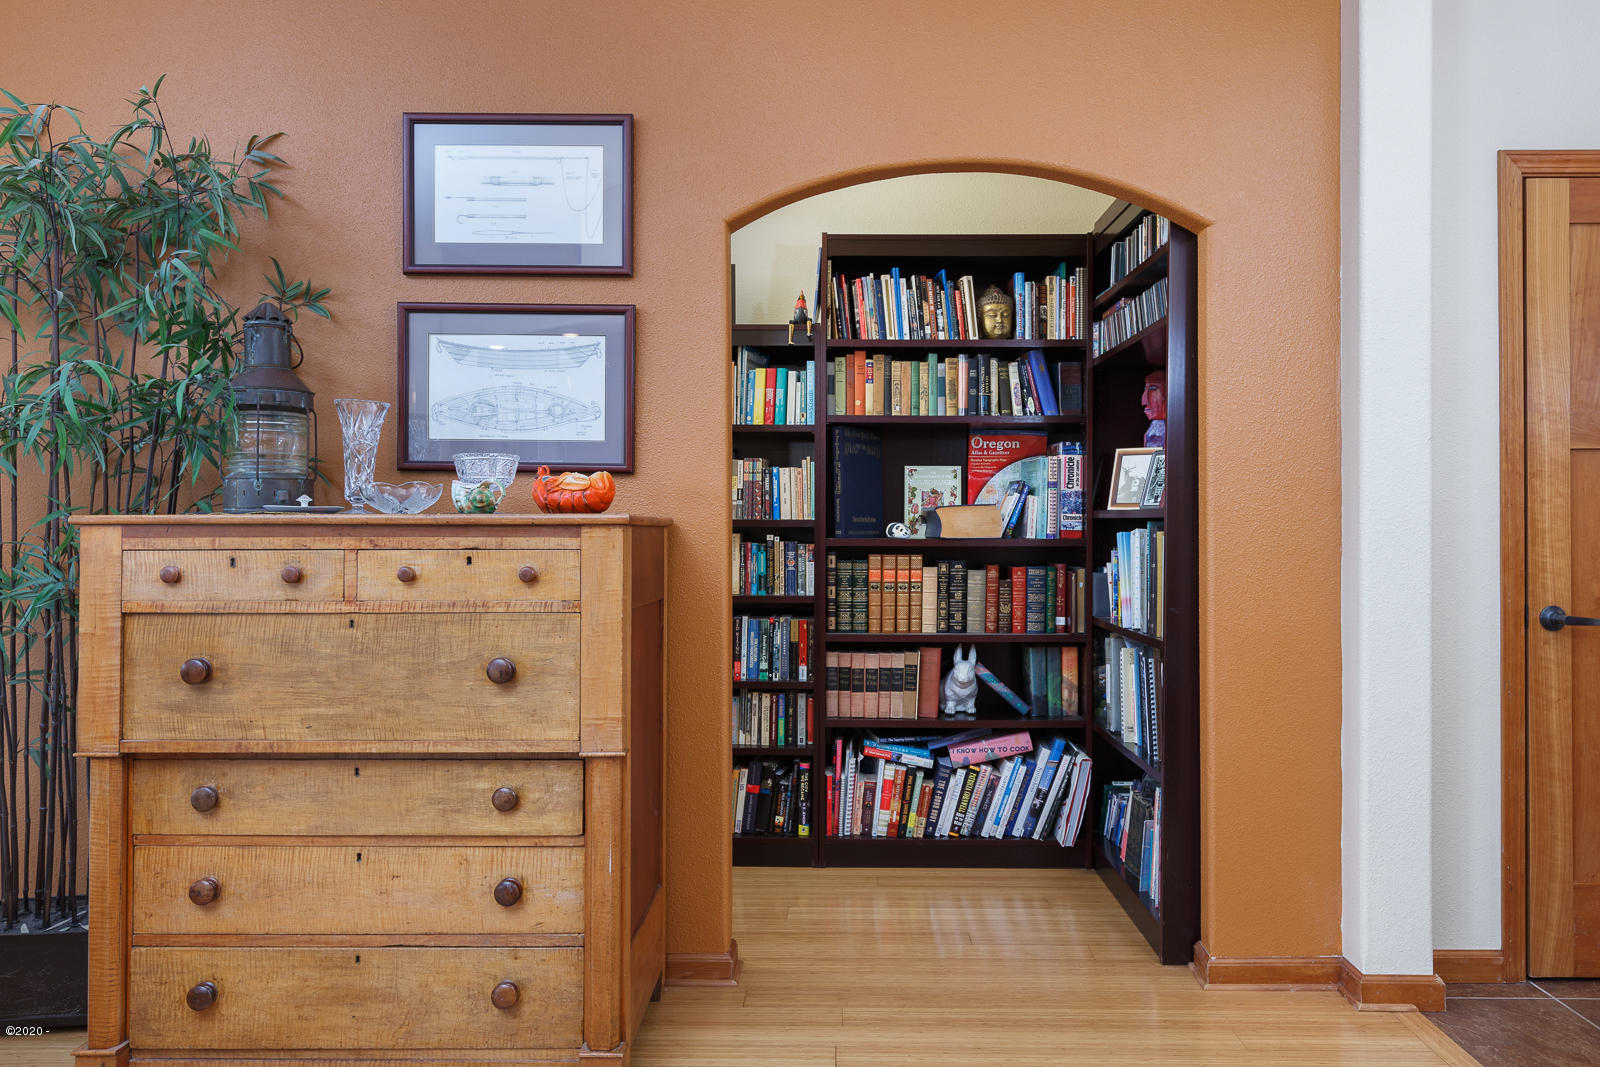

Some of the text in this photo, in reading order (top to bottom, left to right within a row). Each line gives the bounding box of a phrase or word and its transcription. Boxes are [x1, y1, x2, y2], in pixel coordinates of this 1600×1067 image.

[971, 436, 1020, 450] Oregon
[1066, 456, 1074, 489] Chronicle
[938, 780, 946, 790] THE
[959, 772, 976, 813] PATRICIA CORNWELL
[929, 809, 938, 822] BODY
